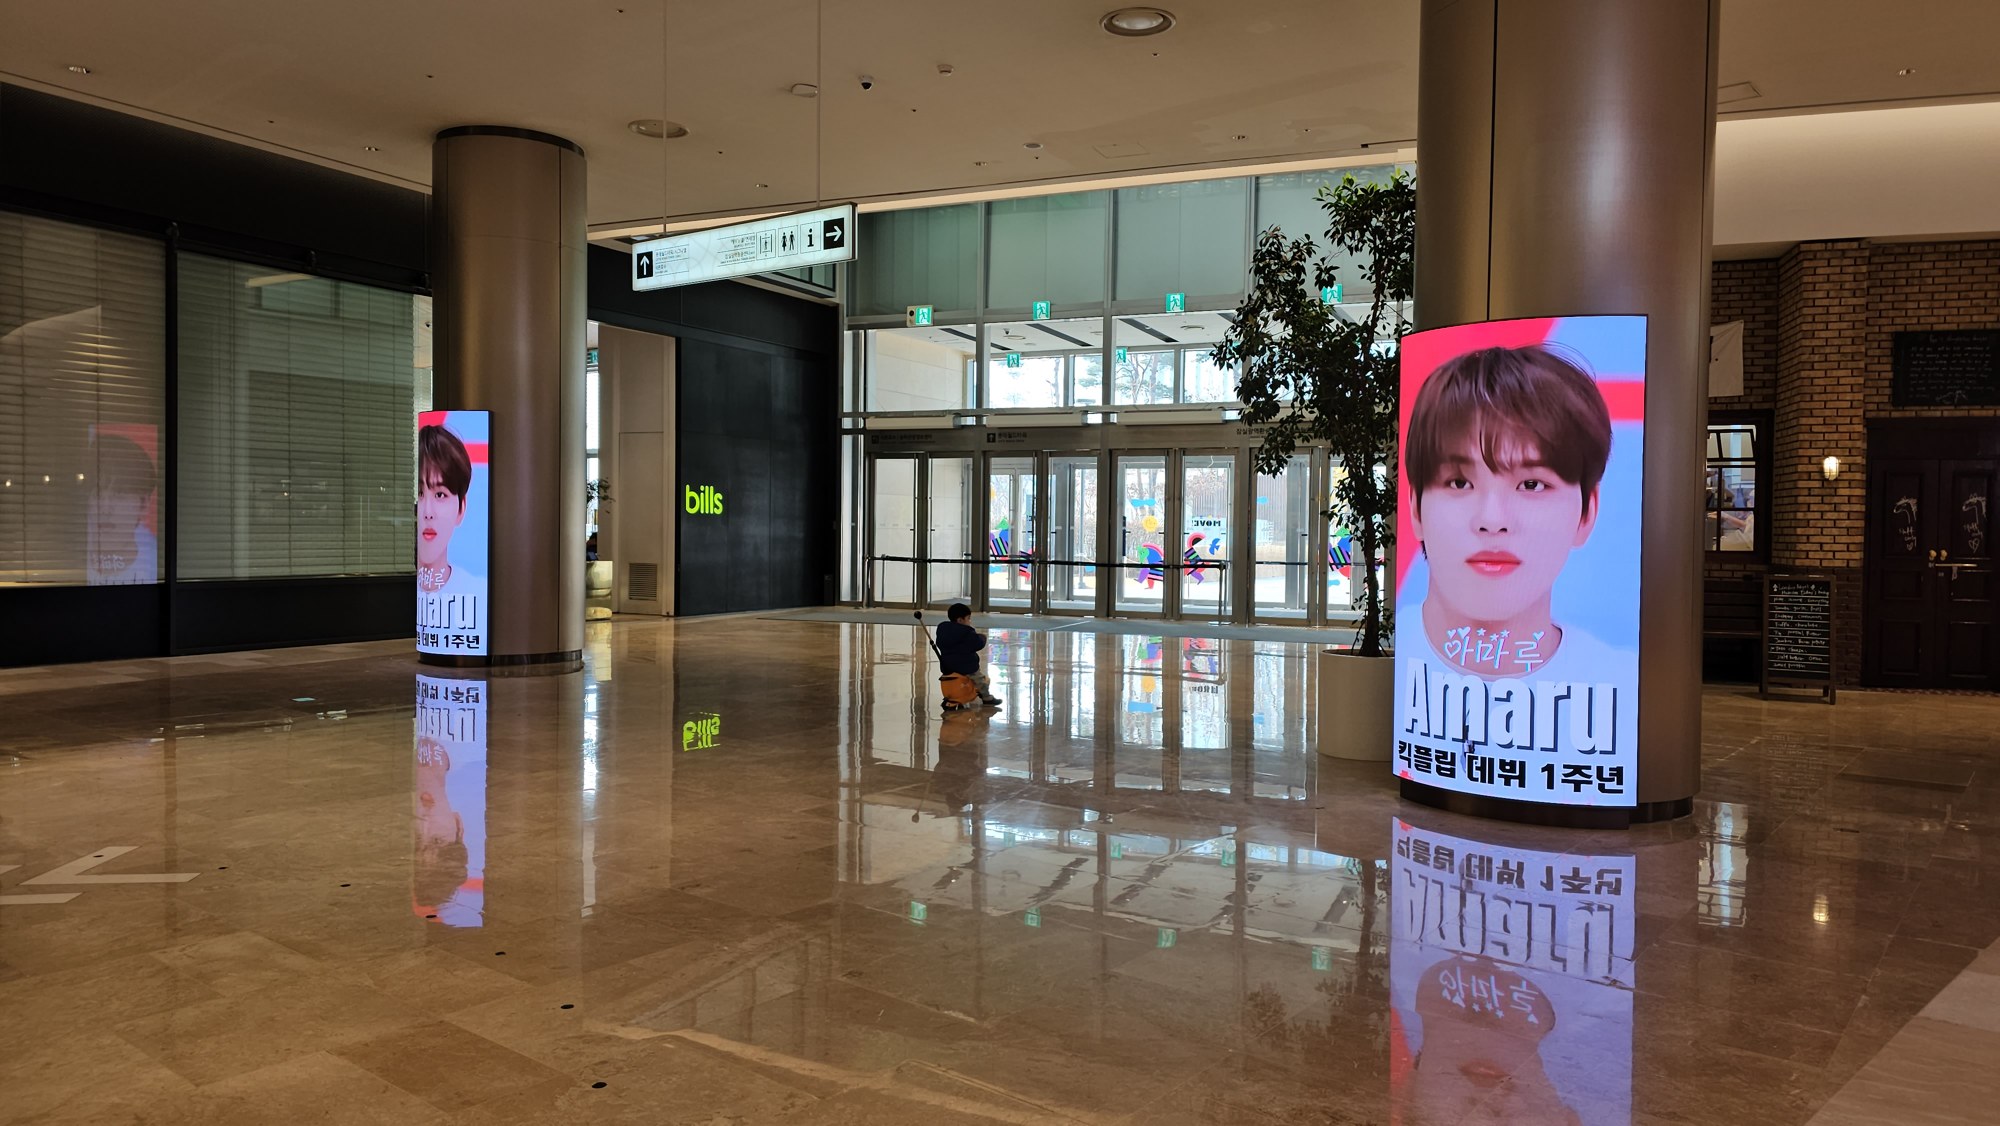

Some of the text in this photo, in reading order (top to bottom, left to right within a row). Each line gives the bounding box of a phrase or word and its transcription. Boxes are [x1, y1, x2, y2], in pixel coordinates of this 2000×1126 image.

[685, 484, 723, 515] bills
[443, 634, 480, 650] 1주년
[1443, 635, 1545, 672] 아마루
[1403, 657, 1618, 756] Amaru
[1398, 739, 1625, 795] 킥플립 데뷔 1주년
